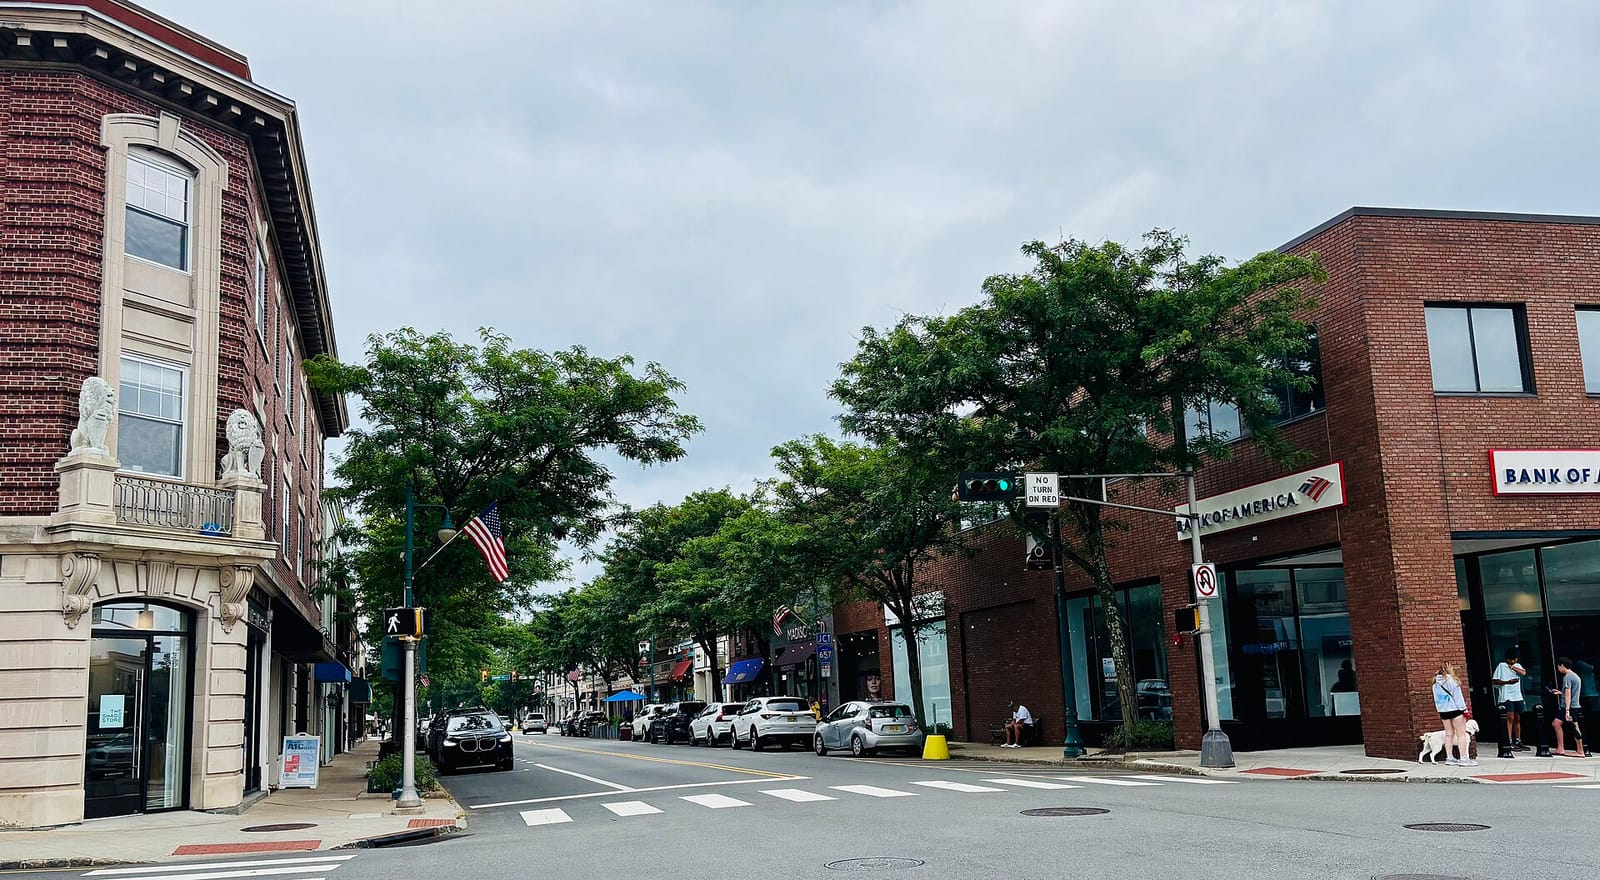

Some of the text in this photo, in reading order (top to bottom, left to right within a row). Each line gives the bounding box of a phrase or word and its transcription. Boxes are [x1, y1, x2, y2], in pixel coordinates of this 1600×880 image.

[1506, 469, 1561, 483] BANK
[1567, 468, 1591, 483] OF
[1028, 495, 1057, 503] ON RED
[1212, 508, 1229, 524] OF
[1231, 492, 1297, 520] AMERICA
[786, 625, 812, 641] MADISO
[818, 634, 831, 643] JCT
[819, 650, 832, 659] 657
